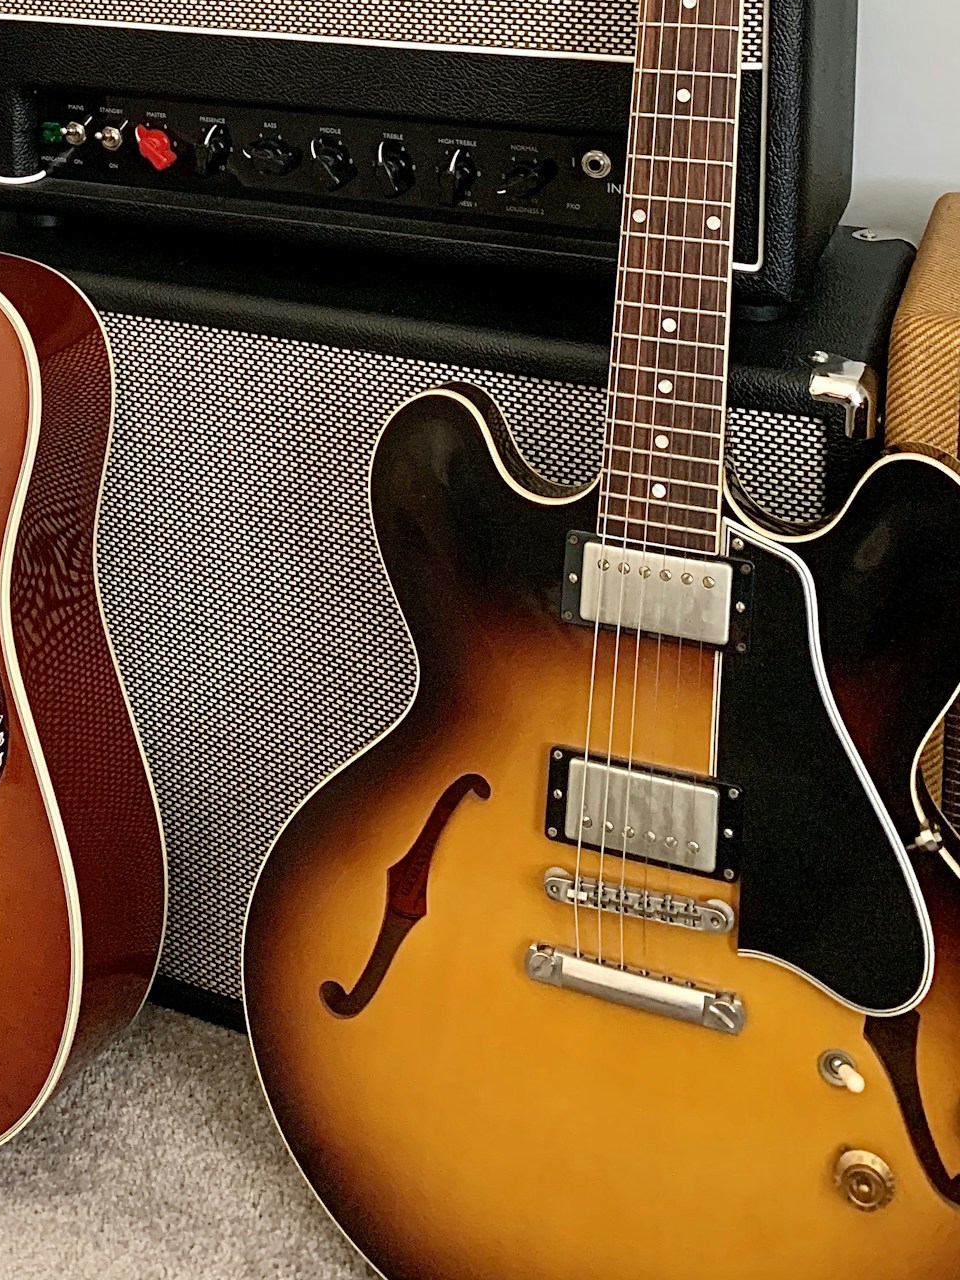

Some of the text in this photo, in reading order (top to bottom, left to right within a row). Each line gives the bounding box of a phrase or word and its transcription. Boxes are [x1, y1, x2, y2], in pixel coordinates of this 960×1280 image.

[99, 106, 124, 115] STANDBY
[146, 111, 167, 119] MASTER
[199, 115, 226, 124] PRESENCE
[319, 126, 341, 135] MIDDLE
[382, 132, 403, 141] TREBLE
[437, 137, 477, 147] HIGH TREBLE
[510, 144, 539, 153] NORMAL
[607, 182, 624, 195] IN
[505, 206, 540, 215] LOUDNESS
